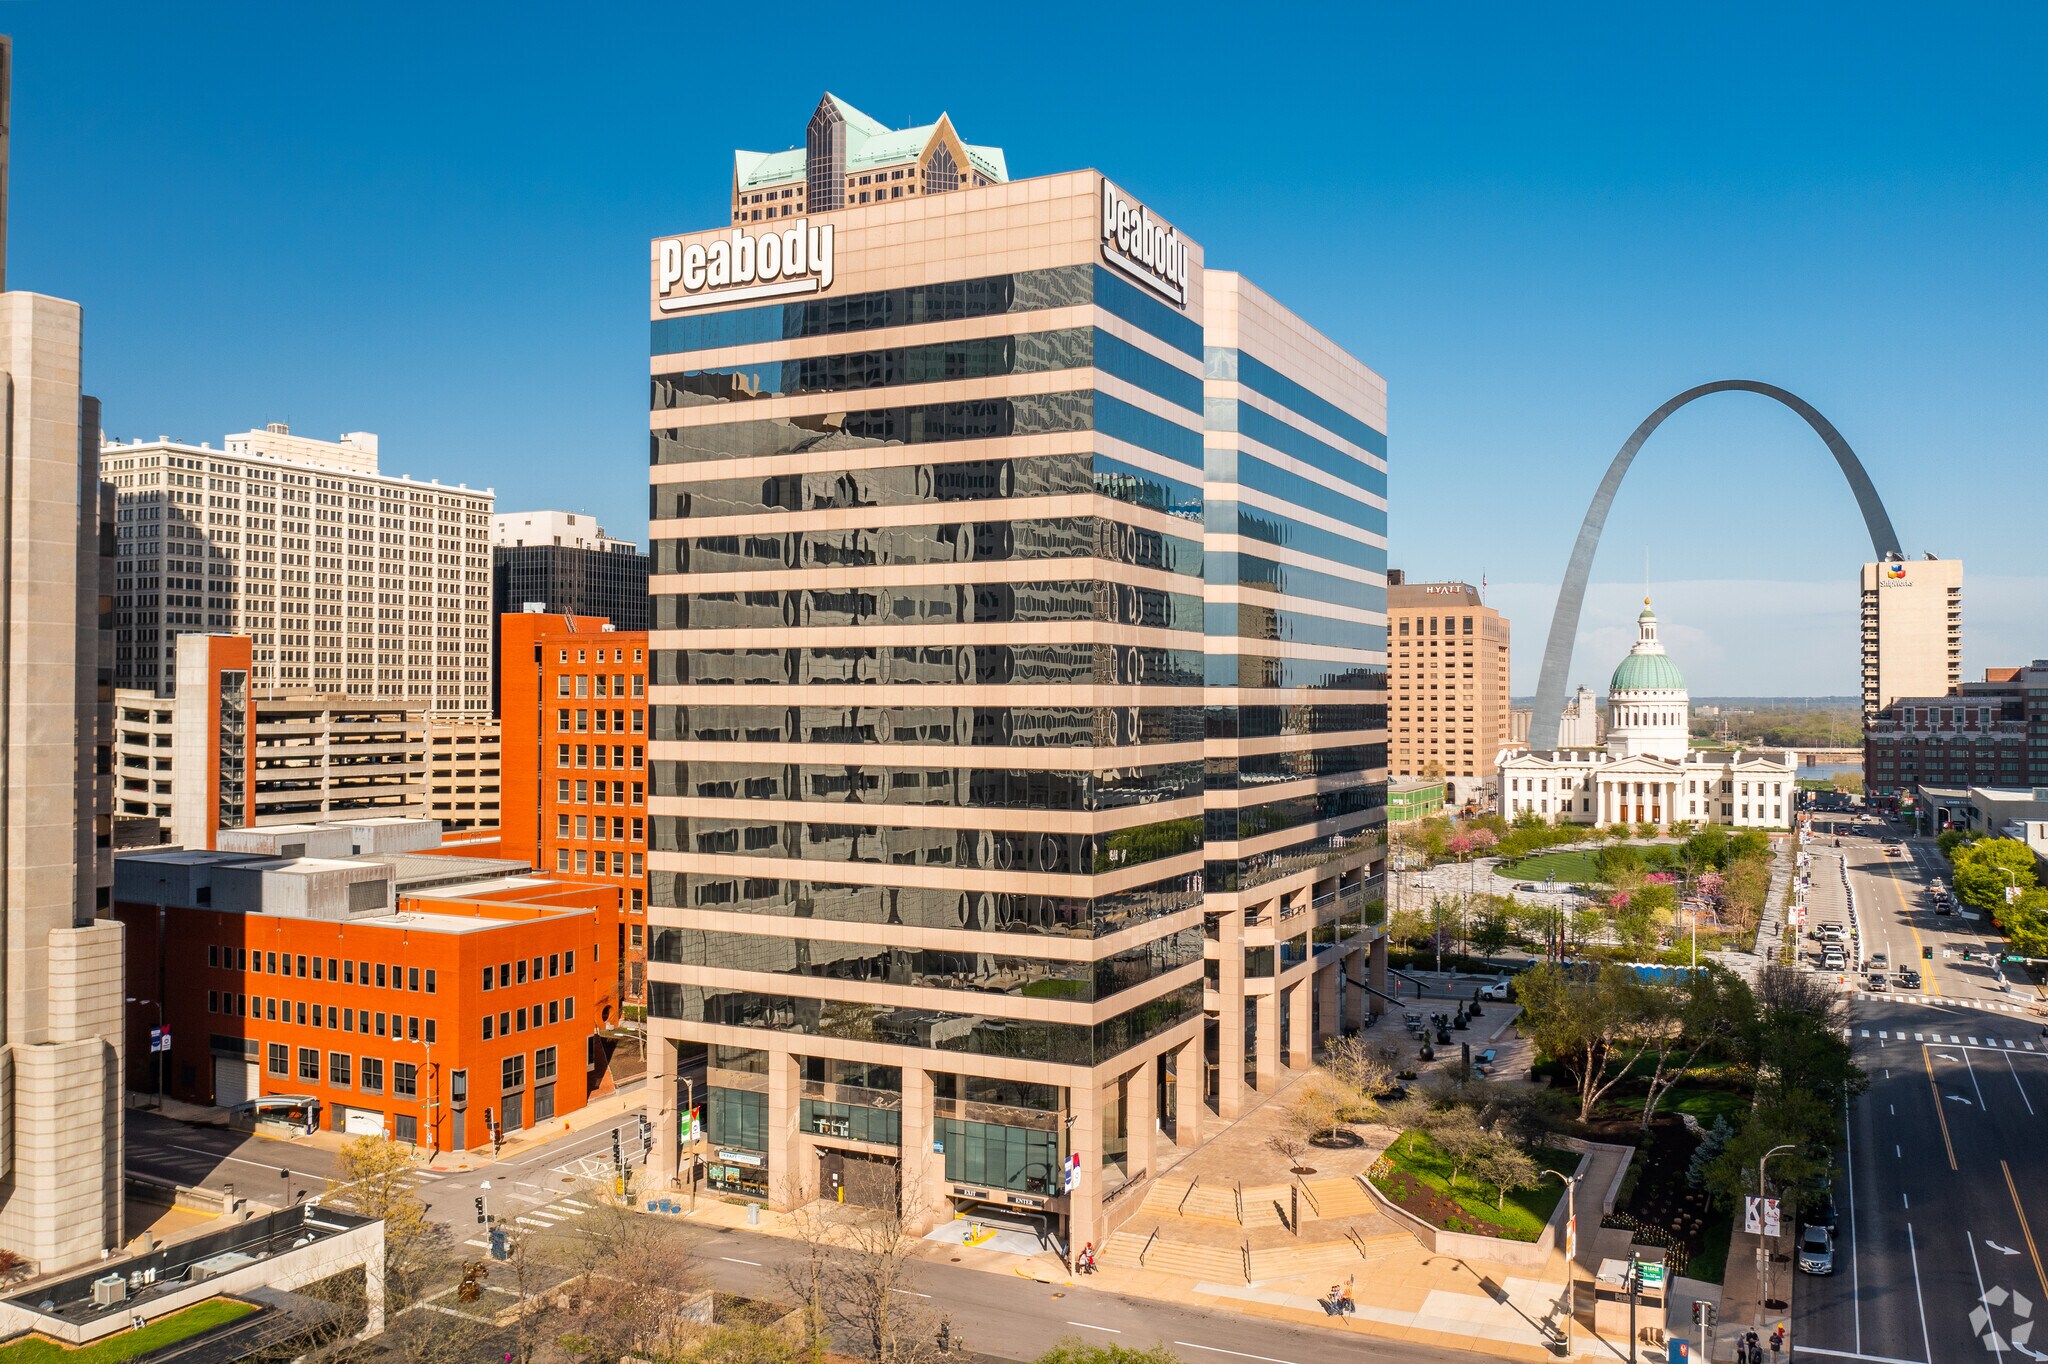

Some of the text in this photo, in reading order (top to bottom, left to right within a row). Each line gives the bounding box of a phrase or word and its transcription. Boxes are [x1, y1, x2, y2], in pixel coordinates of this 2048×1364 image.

[659, 217, 834, 295] Peabody
[1101, 177, 1188, 306] Peabody
[1426, 585, 1461, 595] HYATT
[1615, 1292, 1642, 1304] Peabdy
